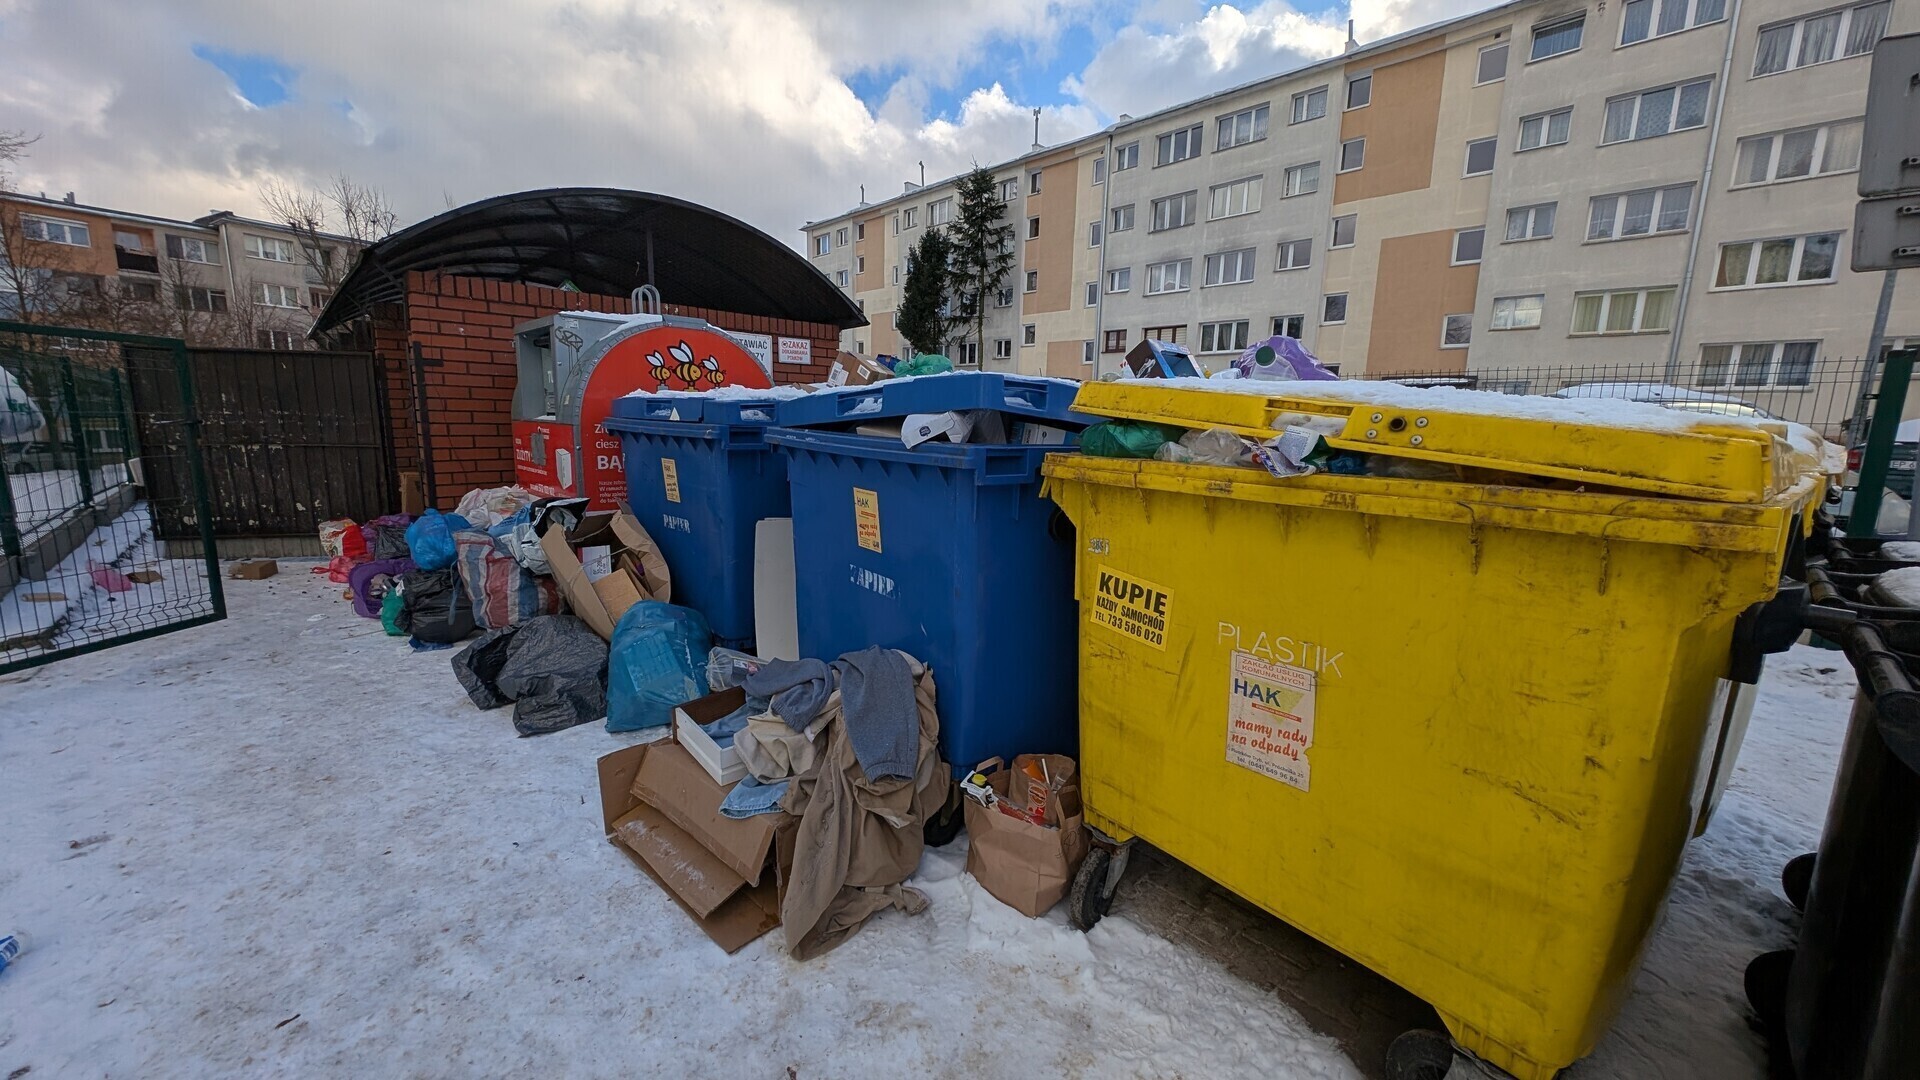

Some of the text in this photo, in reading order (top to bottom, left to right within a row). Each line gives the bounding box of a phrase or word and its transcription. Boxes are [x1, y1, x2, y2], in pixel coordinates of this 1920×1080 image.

[738, 338, 767, 349] TAWIAĆ
[788, 340, 808, 349] ZAKAZ
[596, 439, 619, 449] ciesz
[857, 496, 870, 508] HAK
[1099, 571, 1168, 619] KUPIĘ
[1096, 594, 1164, 631] KAŻDY SAMOCHÓD
[1095, 610, 1163, 646] TEL. 733 586 020
[1218, 621, 1344, 679] PLASTIK
[1241, 664, 1305, 687] KOMUNALNYCH
[1234, 677, 1281, 708] HAK
[1231, 733, 1298, 761] na odpady
[1235, 719, 1308, 747] mamy rady
[1280, 772, 1288, 780] 96
